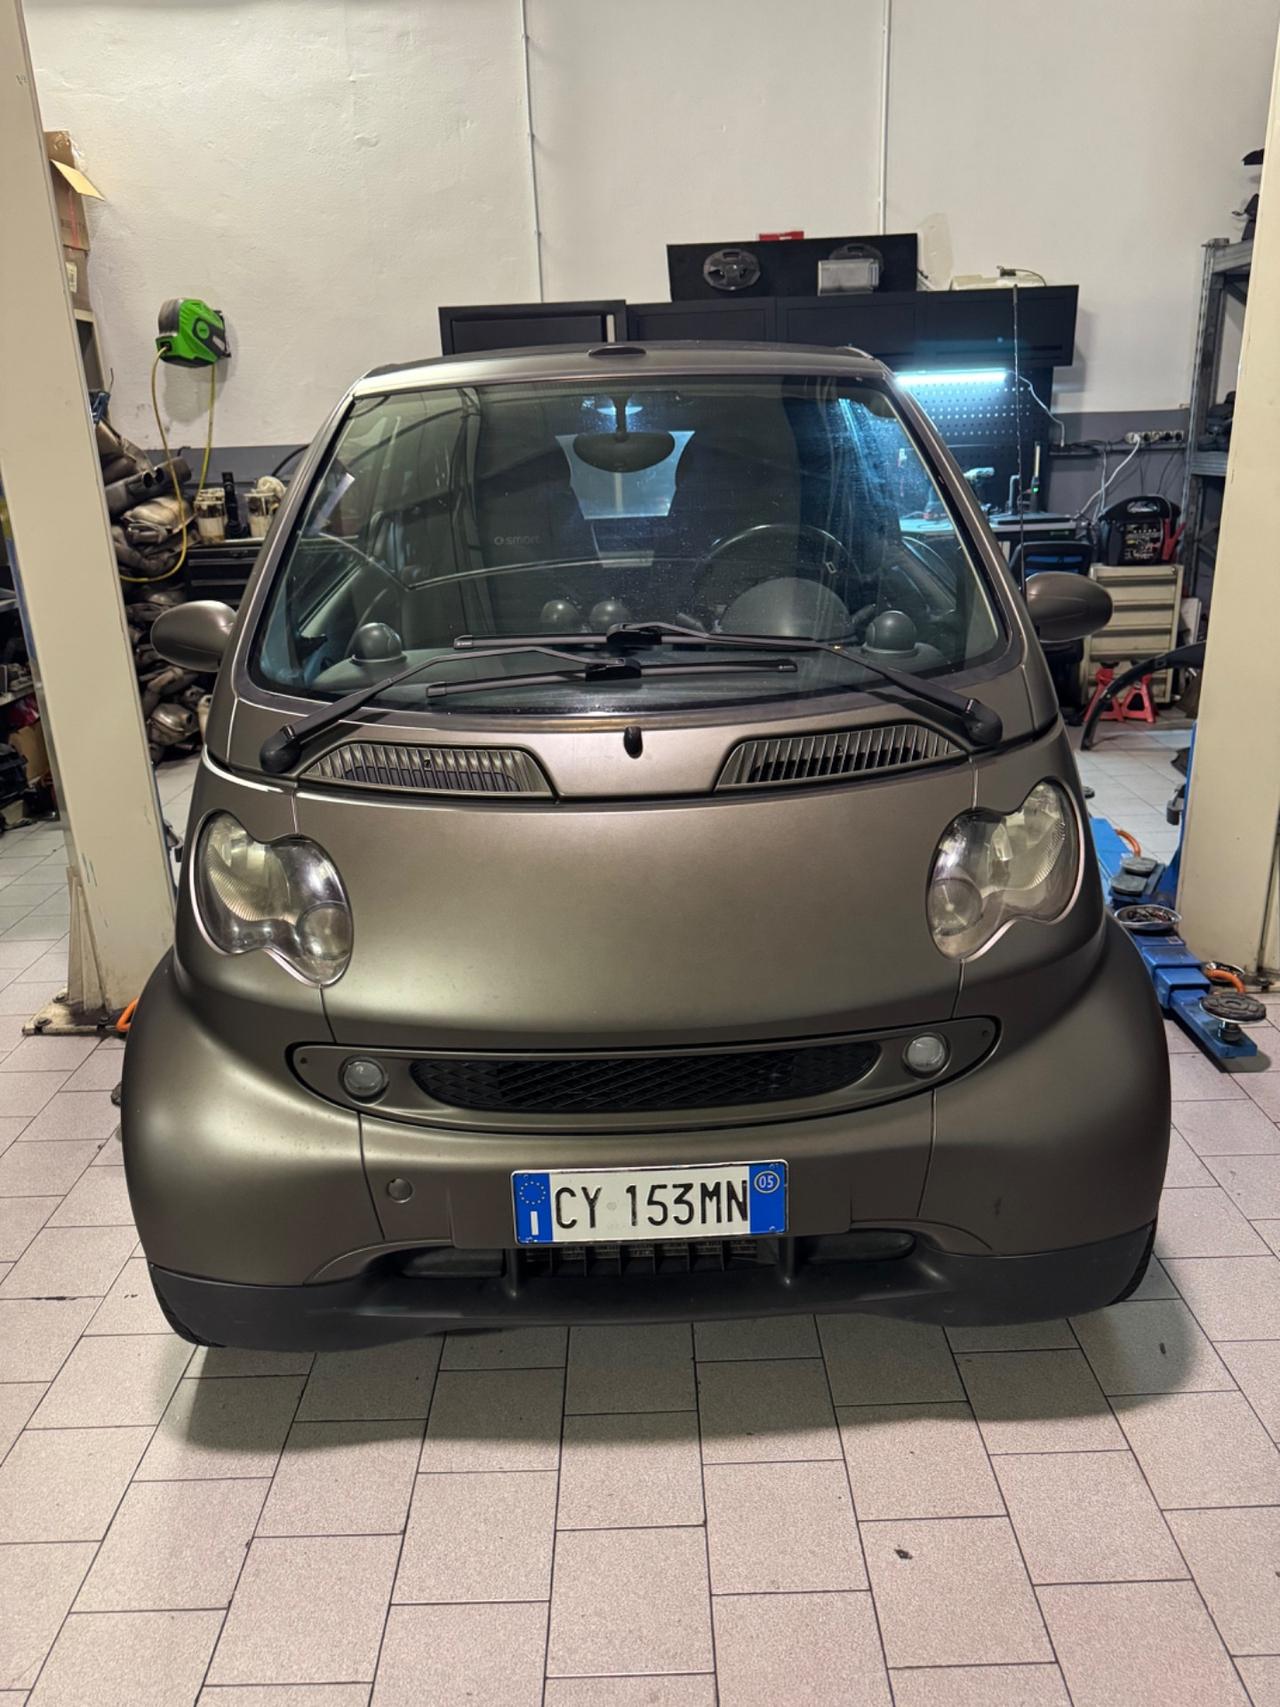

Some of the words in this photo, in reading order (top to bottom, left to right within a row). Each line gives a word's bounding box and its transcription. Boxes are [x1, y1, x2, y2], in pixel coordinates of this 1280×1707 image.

[758, 1174, 775, 1189] 05
[555, 1186, 602, 1229] CY
[625, 1179, 748, 1226] 153MN
[530, 1211, 539, 1236] I
